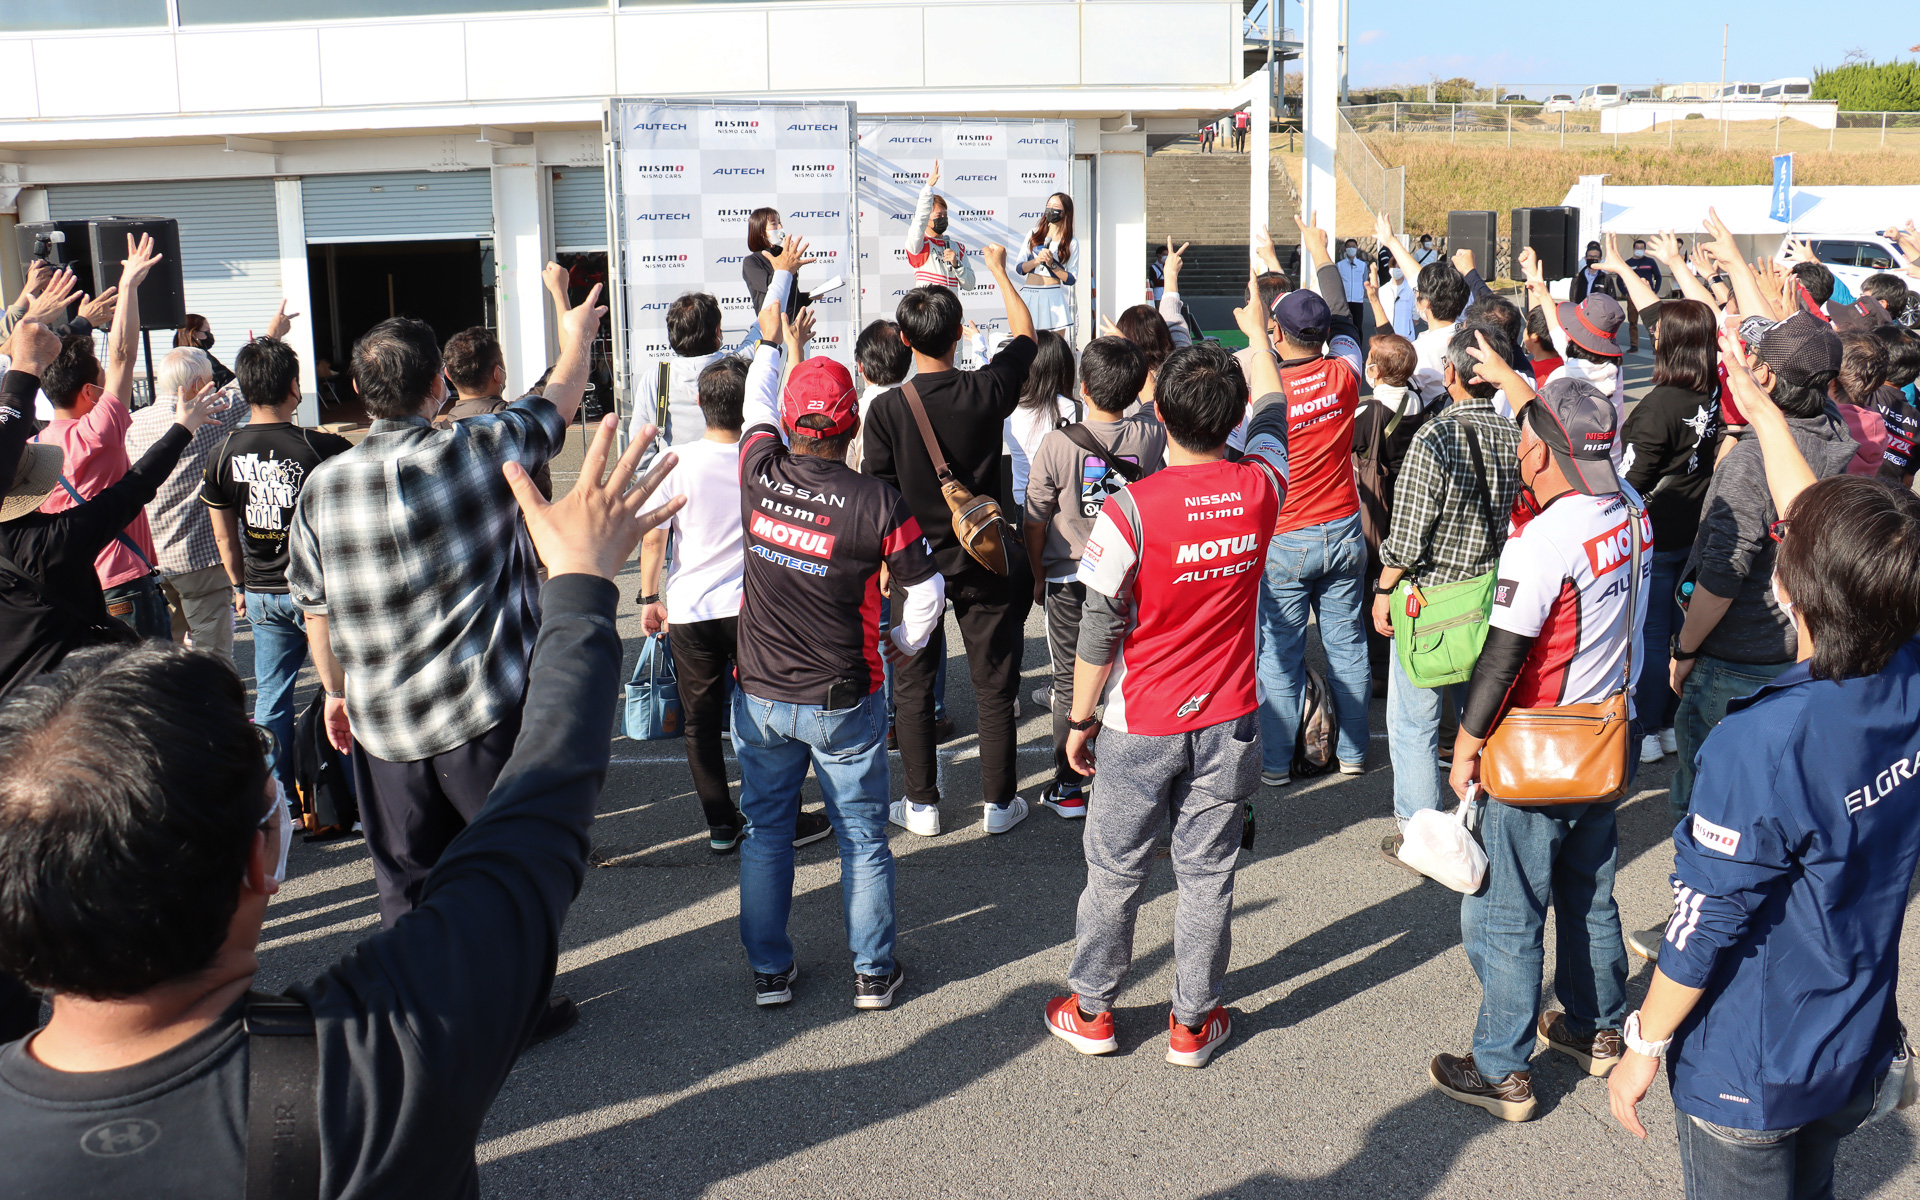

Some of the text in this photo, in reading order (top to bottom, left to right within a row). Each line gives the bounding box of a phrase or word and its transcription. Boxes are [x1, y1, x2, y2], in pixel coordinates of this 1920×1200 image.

[633, 123, 687, 131] AUTECH
[789, 210, 840, 218] AUTECH
[640, 302, 670, 310] AUT
[1290, 371, 1326, 387] NISSAN
[807, 400, 825, 410] 23
[1290, 392, 1339, 418] MOTUL
[1290, 408, 1343, 432] AUTECH
[1583, 442, 1612, 451] nism
[1883, 450, 1907, 467] TECH
[759, 474, 845, 509] NISSAN
[1184, 491, 1242, 507] NISSAN
[247, 507, 281, 528] 2014
[752, 516, 828, 555] MOTUL
[1175, 533, 1258, 564] MOTUL
[749, 544, 828, 576] AUTECH
[1172, 556, 1259, 585] AUTECH
